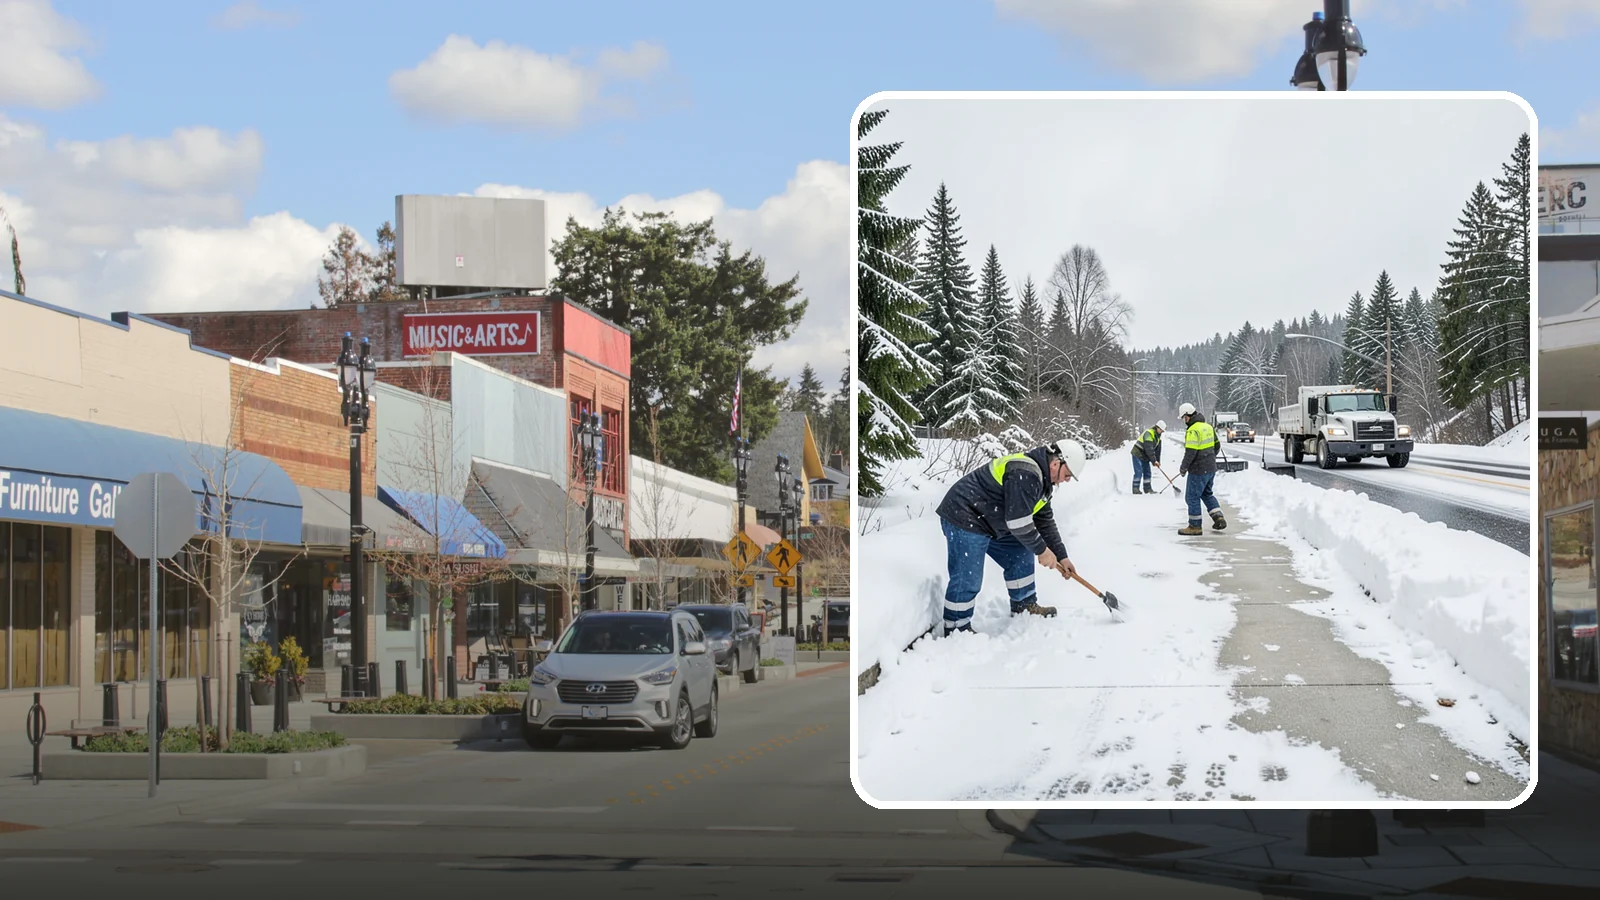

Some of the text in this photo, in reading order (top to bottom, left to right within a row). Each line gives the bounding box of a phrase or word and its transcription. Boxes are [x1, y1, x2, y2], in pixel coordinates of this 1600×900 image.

[0, 471, 121, 519] Furniture Gal
[453, 563, 479, 574] SUSHI
[327, 594, 352, 607] HAIR SAL
